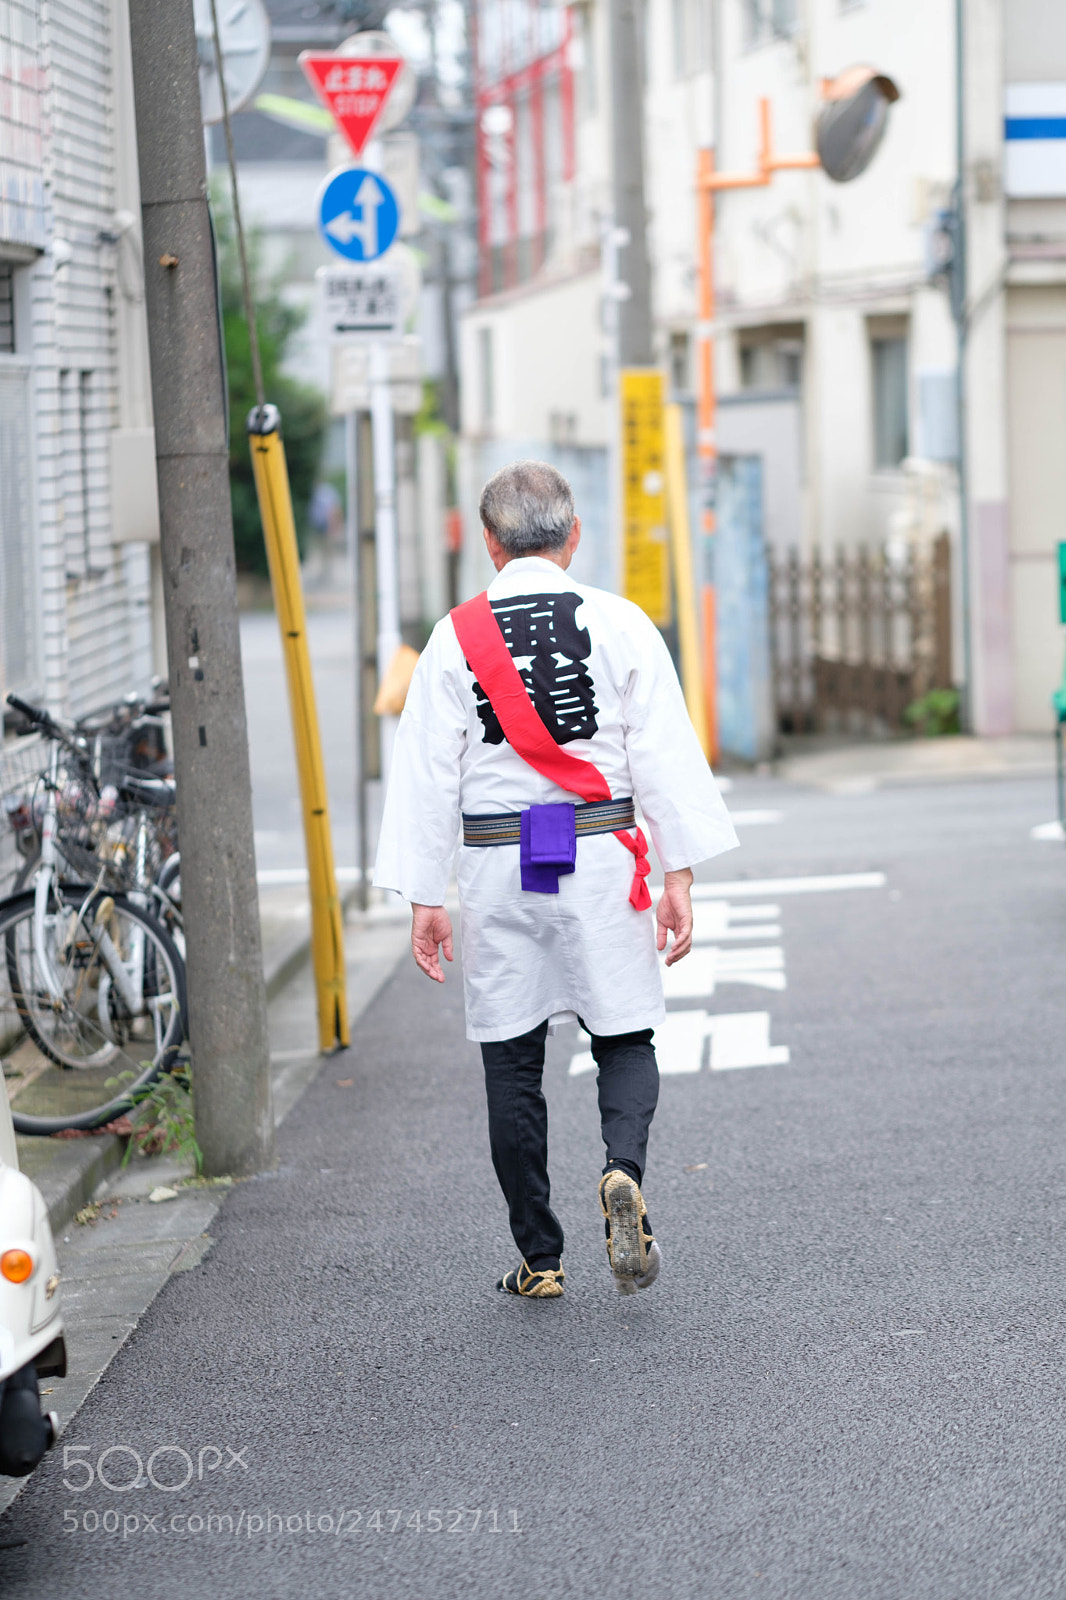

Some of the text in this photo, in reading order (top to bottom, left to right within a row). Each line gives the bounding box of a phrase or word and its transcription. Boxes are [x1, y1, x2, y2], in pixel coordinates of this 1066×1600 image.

[324, 65, 388, 92] 止まれ
[334, 94, 380, 117] STOP
